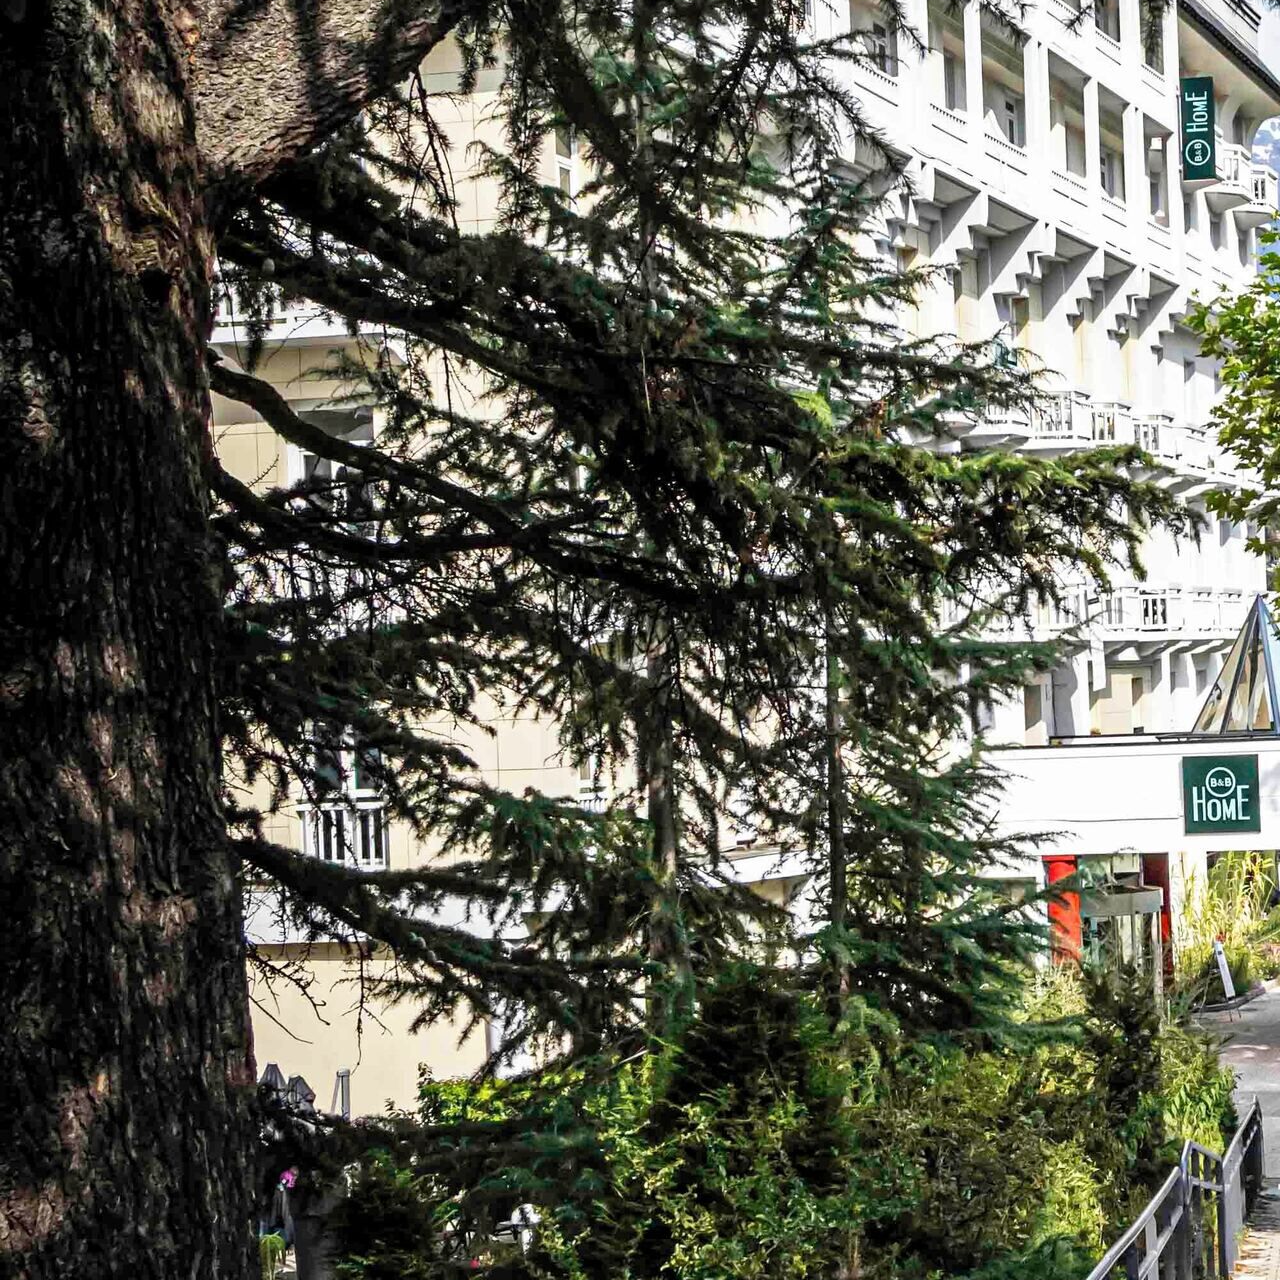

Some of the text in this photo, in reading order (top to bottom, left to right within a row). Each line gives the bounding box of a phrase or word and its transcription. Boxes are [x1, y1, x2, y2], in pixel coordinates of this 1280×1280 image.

[1185, 91, 1208, 162] B&B HOME
[1210, 777, 1231, 787] B&B
[1192, 785, 1250, 821] HOME
